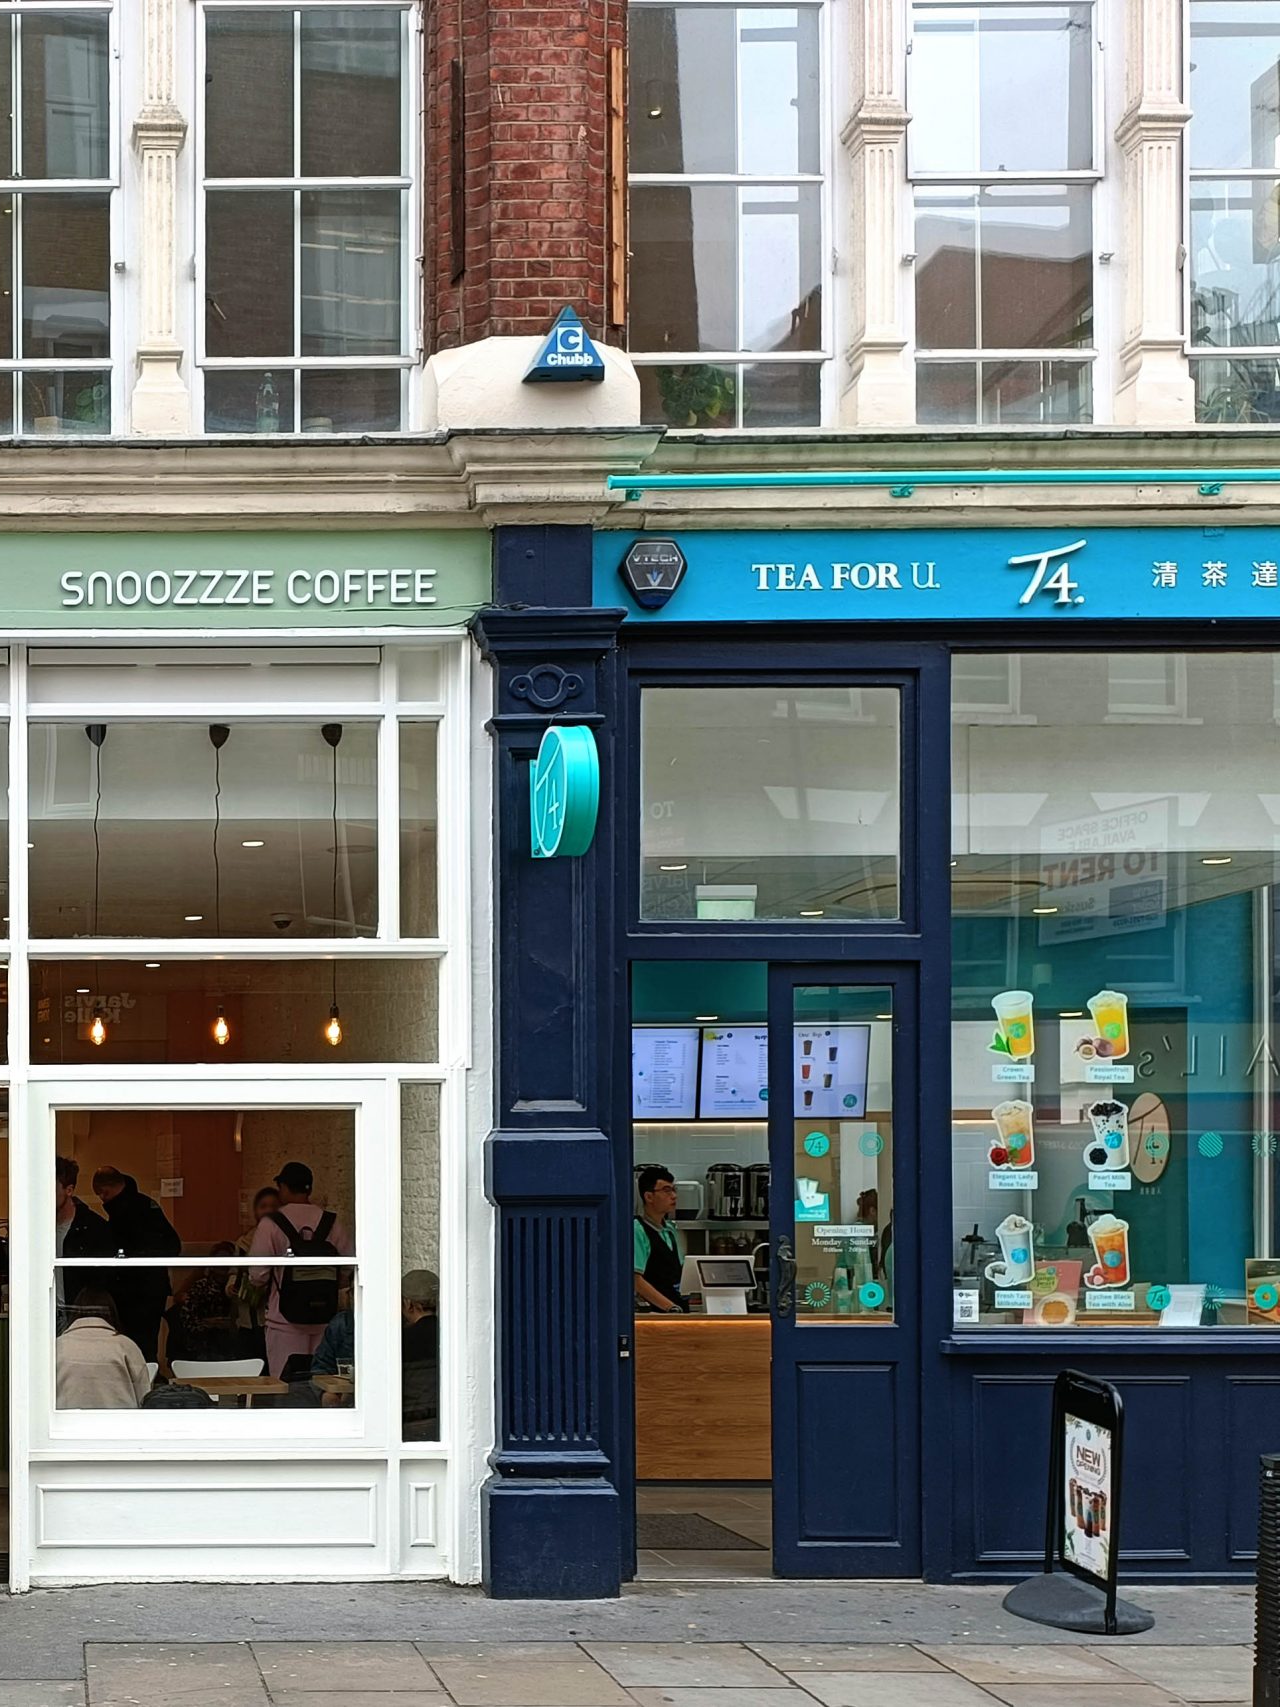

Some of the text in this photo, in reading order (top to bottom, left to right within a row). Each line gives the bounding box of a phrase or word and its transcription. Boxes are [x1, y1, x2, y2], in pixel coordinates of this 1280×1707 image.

[546, 352, 594, 366] Chubb
[751, 563, 823, 590] TEA
[831, 562, 902, 589] FOR
[287, 569, 437, 605] COFFEE
[1094, 1074, 1114, 1082] Royal
[992, 1173, 1034, 1181] Elegant Lady
[816, 1226, 872, 1236] Opening Hours
[811, 1238, 842, 1248] Monday
[849, 1237, 877, 1248] Sunday
[1076, 1445, 1102, 1467] NEW
[1076, 1461, 1101, 1475] OPENING
